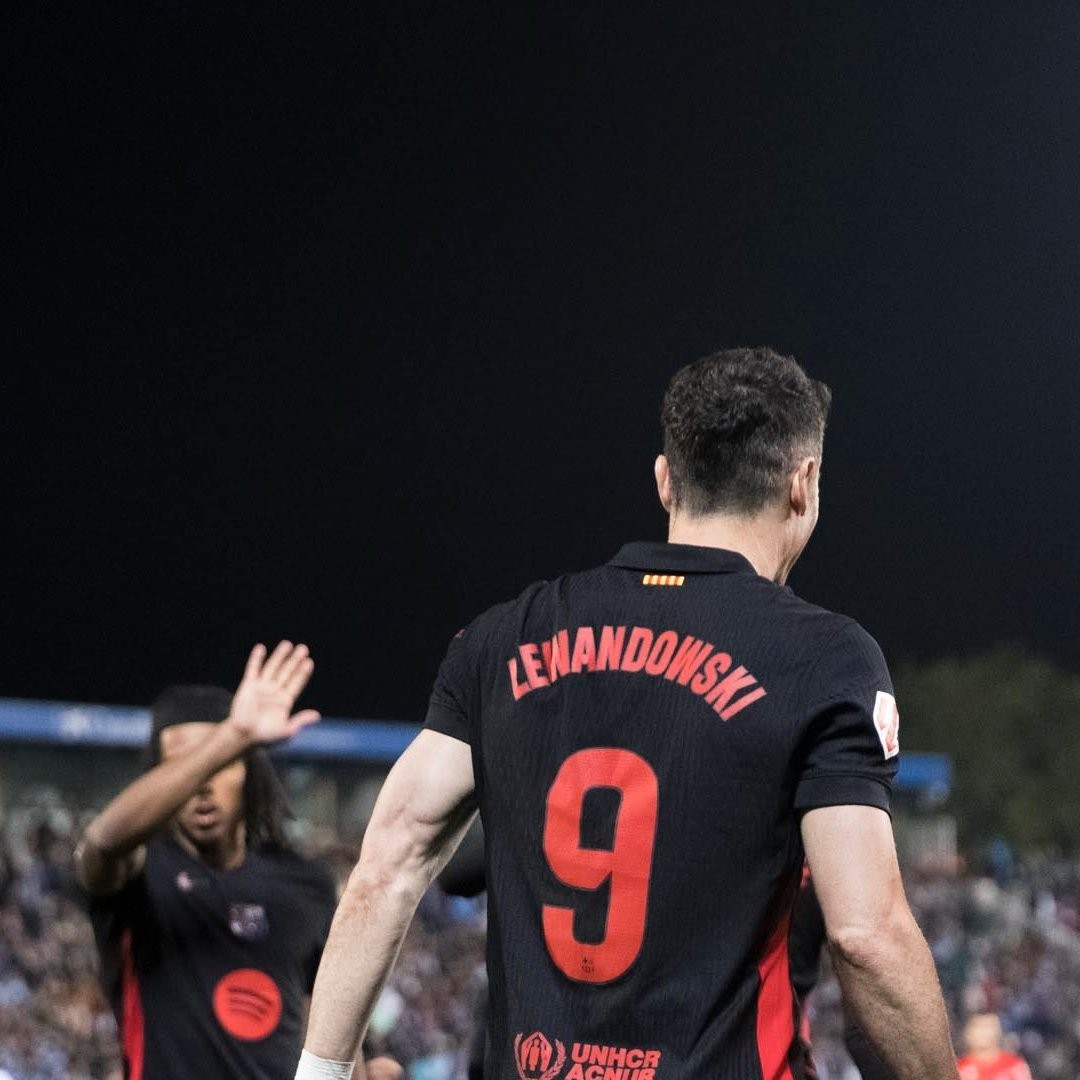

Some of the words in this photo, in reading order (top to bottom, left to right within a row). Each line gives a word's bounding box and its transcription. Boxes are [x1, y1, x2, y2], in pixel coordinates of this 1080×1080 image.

[507, 625, 768, 722] LEWANDOWSKI
[541, 746, 660, 984] 9
[571, 1043, 661, 1068] UNHCR
